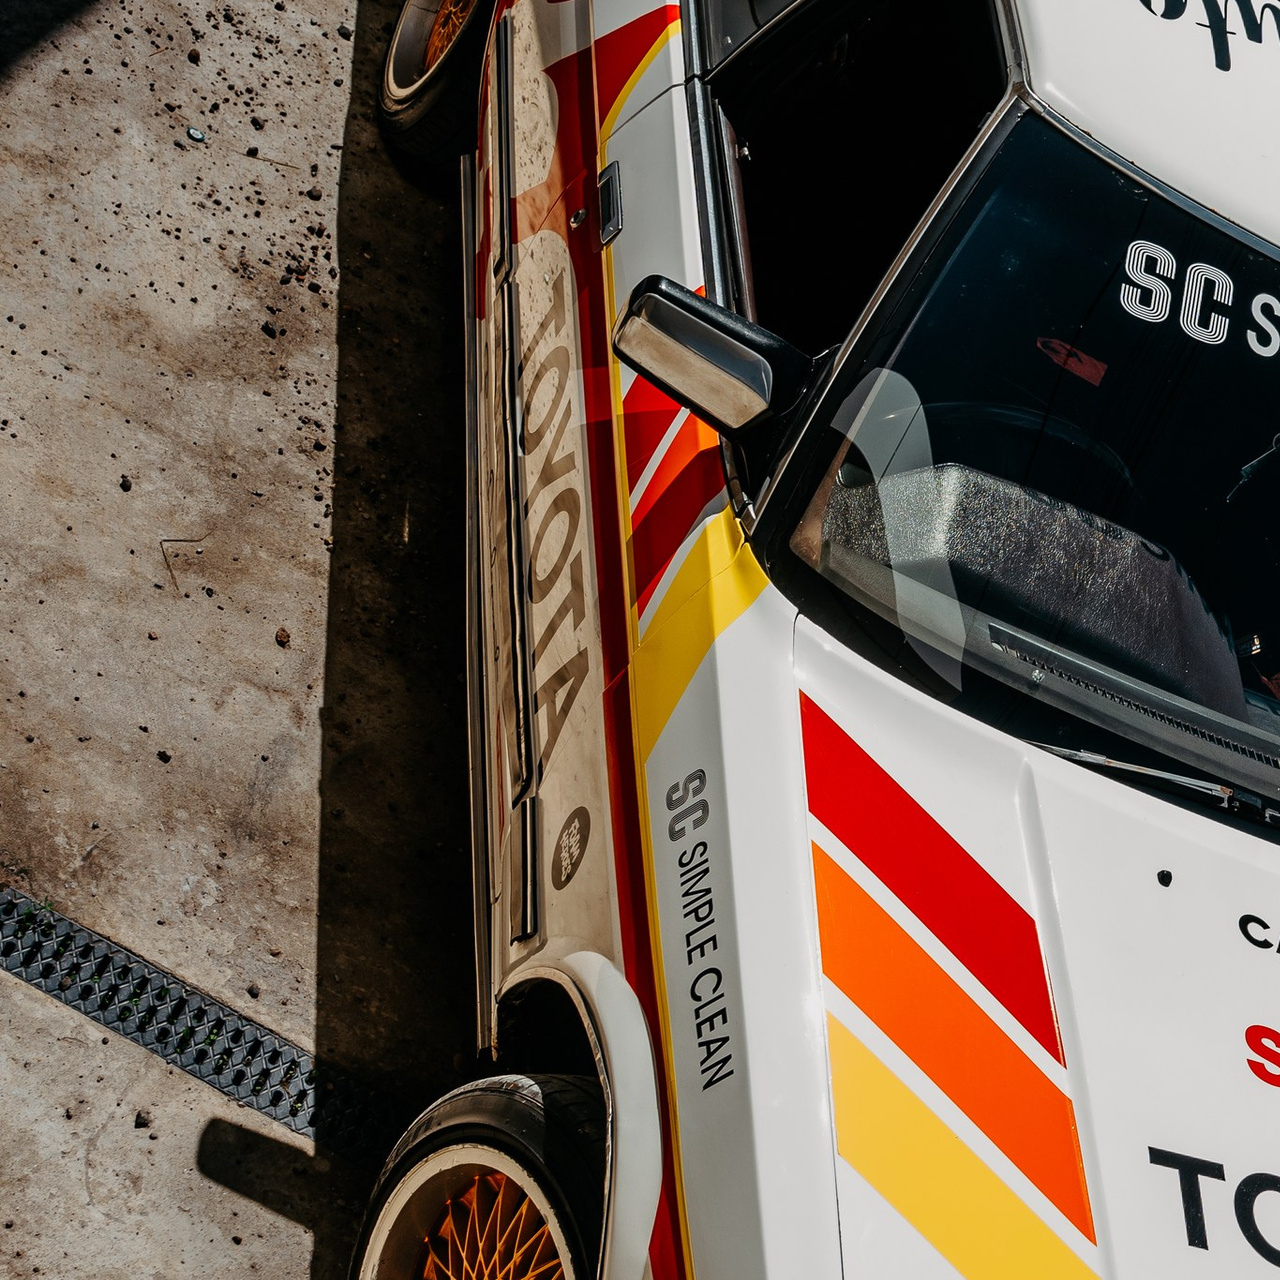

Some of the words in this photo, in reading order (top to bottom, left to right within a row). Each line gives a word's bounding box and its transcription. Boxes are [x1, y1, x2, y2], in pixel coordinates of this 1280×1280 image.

[1120, 240, 1234, 345] SC
[518, 269, 590, 793] TOYOTA
[666, 768, 710, 842] SC
[677, 840, 719, 966] SIMPLE
[689, 966, 735, 1093] CLEAN
